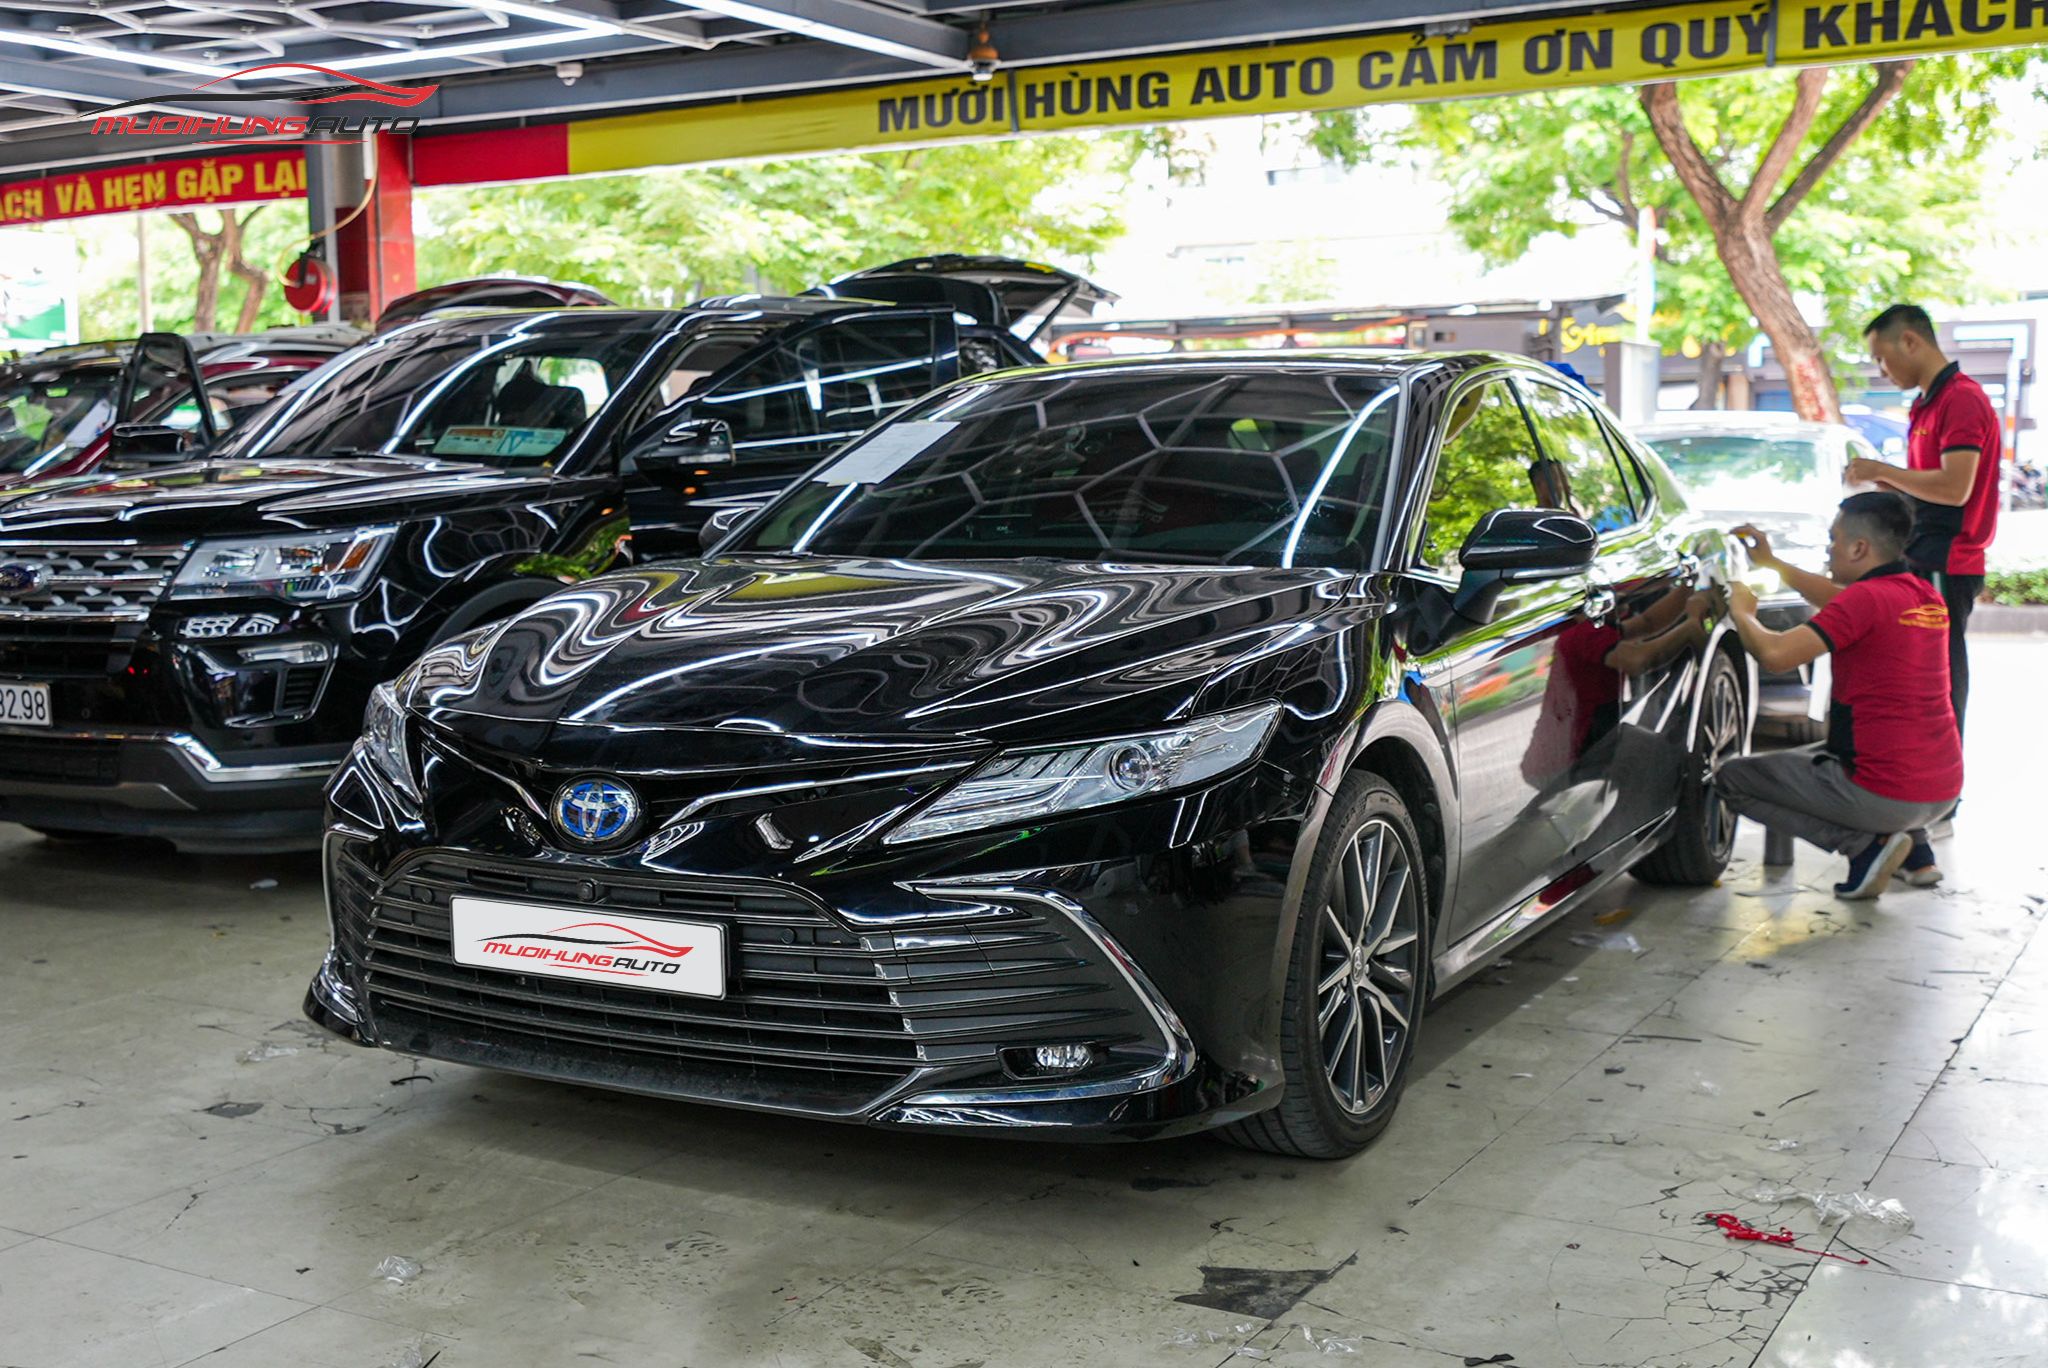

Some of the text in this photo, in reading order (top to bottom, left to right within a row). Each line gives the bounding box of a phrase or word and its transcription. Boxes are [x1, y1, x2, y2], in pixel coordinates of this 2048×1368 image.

[878, 80, 1004, 132] MƯỜI
[1024, 71, 1170, 119] HÙNG
[1190, 57, 1334, 105] AUTO
[1358, 34, 1498, 90] CẢM
[1523, 28, 1613, 75] ƠN
[1641, 4, 1768, 68] QUÝ
[55, 176, 96, 214] VÀ
[103, 170, 166, 211] HẸN
[176, 158, 244, 203] GẶP
[254, 159, 307, 198] LẠI
